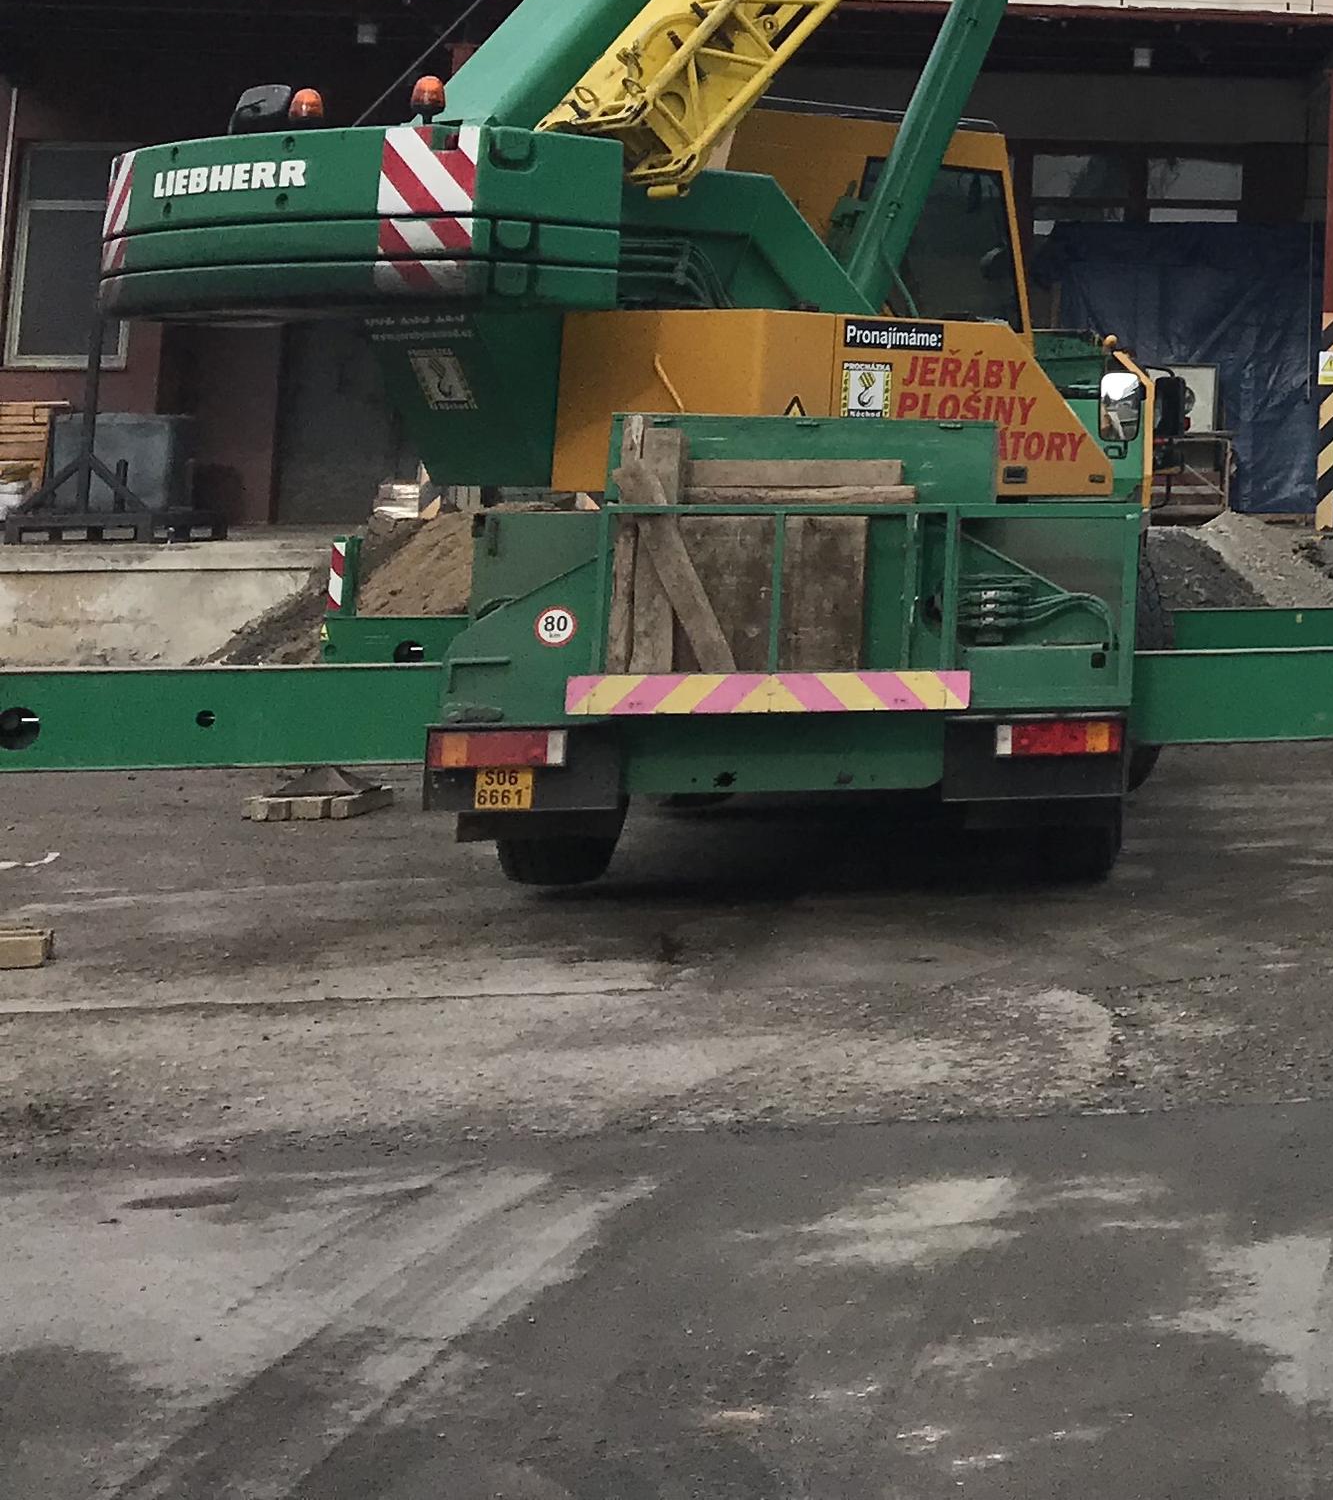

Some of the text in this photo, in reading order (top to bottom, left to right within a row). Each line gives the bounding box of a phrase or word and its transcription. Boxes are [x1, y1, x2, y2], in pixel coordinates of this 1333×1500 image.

[153, 160, 306, 199] LIEBHERR
[846, 325, 943, 349] Pronajímáme:
[902, 350, 1026, 390] JEŘÁBY
[896, 388, 1037, 426] PLOŠINY
[544, 615, 568, 632] 80
[476, 788, 523, 806] 6661
